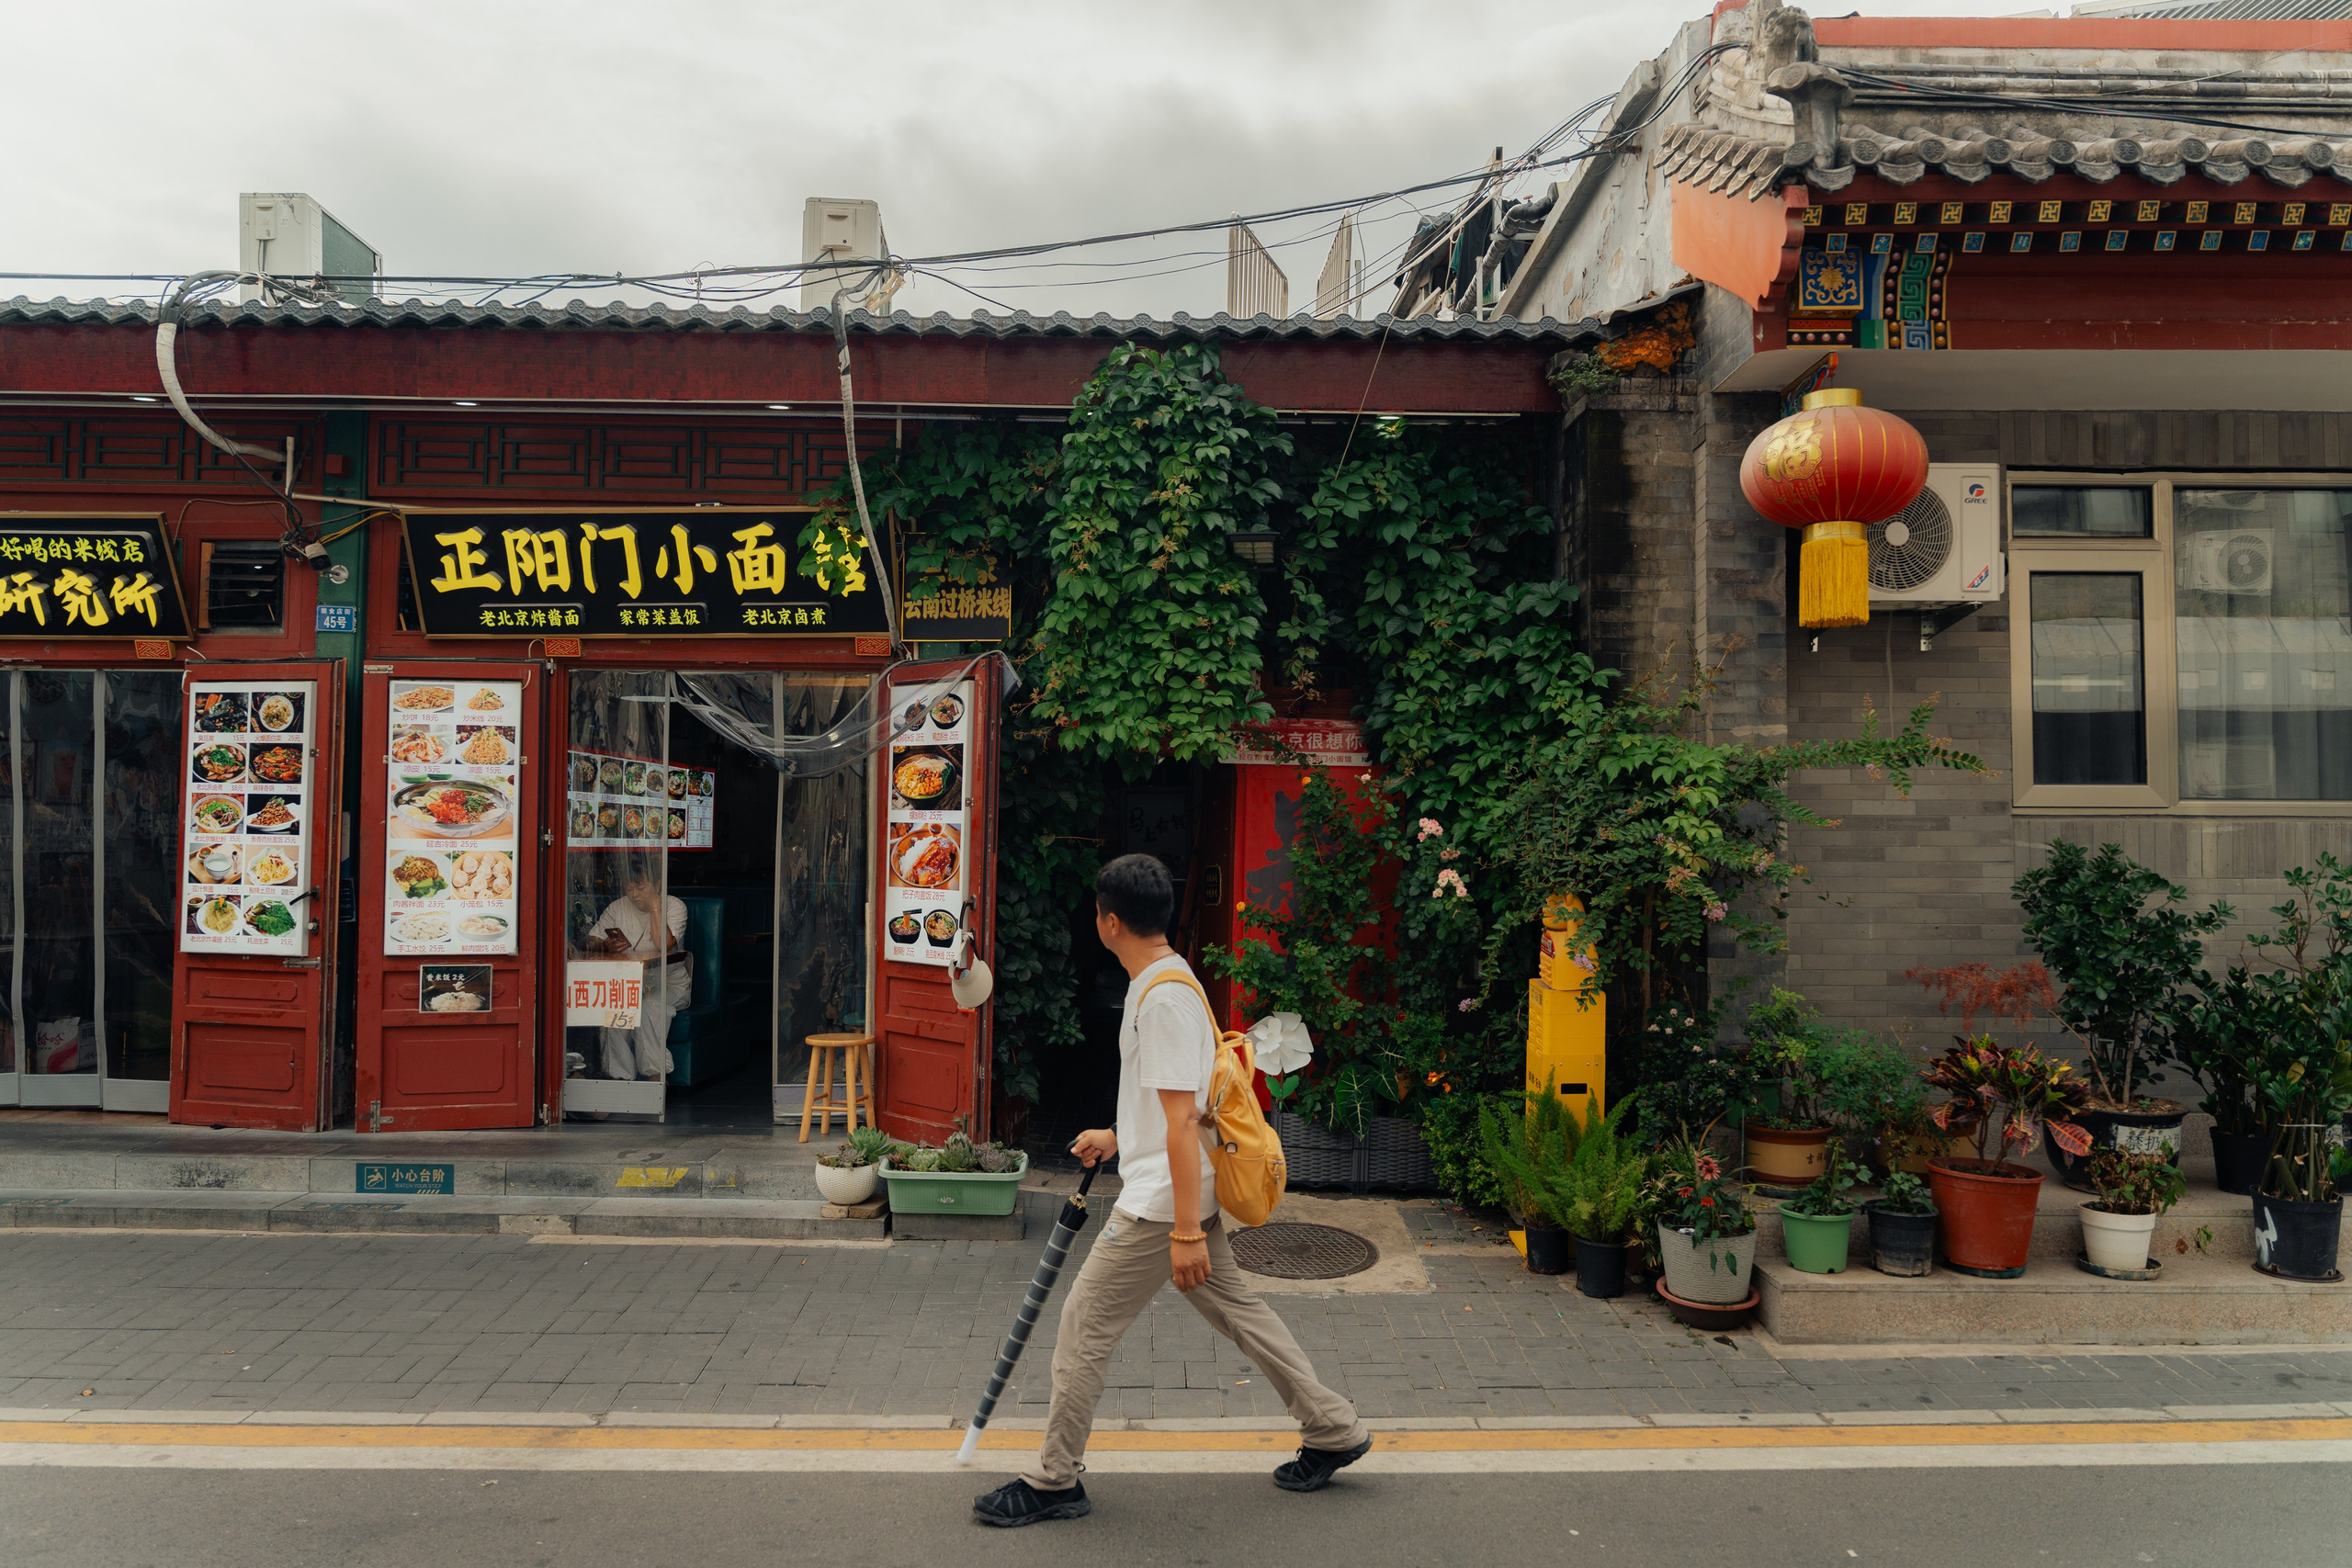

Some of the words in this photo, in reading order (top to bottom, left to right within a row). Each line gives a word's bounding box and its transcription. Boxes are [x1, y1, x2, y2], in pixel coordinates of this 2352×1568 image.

[0, 536, 144, 563] 好喝的米线店
[904, 588, 1010, 619] 云南过桥米线
[323, 616, 346, 628] 45号
[479, 609, 580, 627] 老北京炸酱面
[619, 608, 700, 626] 家常菜盖饭
[741, 607, 826, 626] 老北京卤煮
[1233, 731, 1363, 750] 北京很想你
[929, 811, 943, 820] 25元
[902, 889, 932, 900] 把子肉盖饭
[933, 892, 945, 901] 28元
[398, 944, 426, 953] 手工水饺
[461, 944, 489, 953] 鲜肉馄饨
[492, 944, 506, 953] 20元
[391, 1168, 445, 1182] 小心台阶
